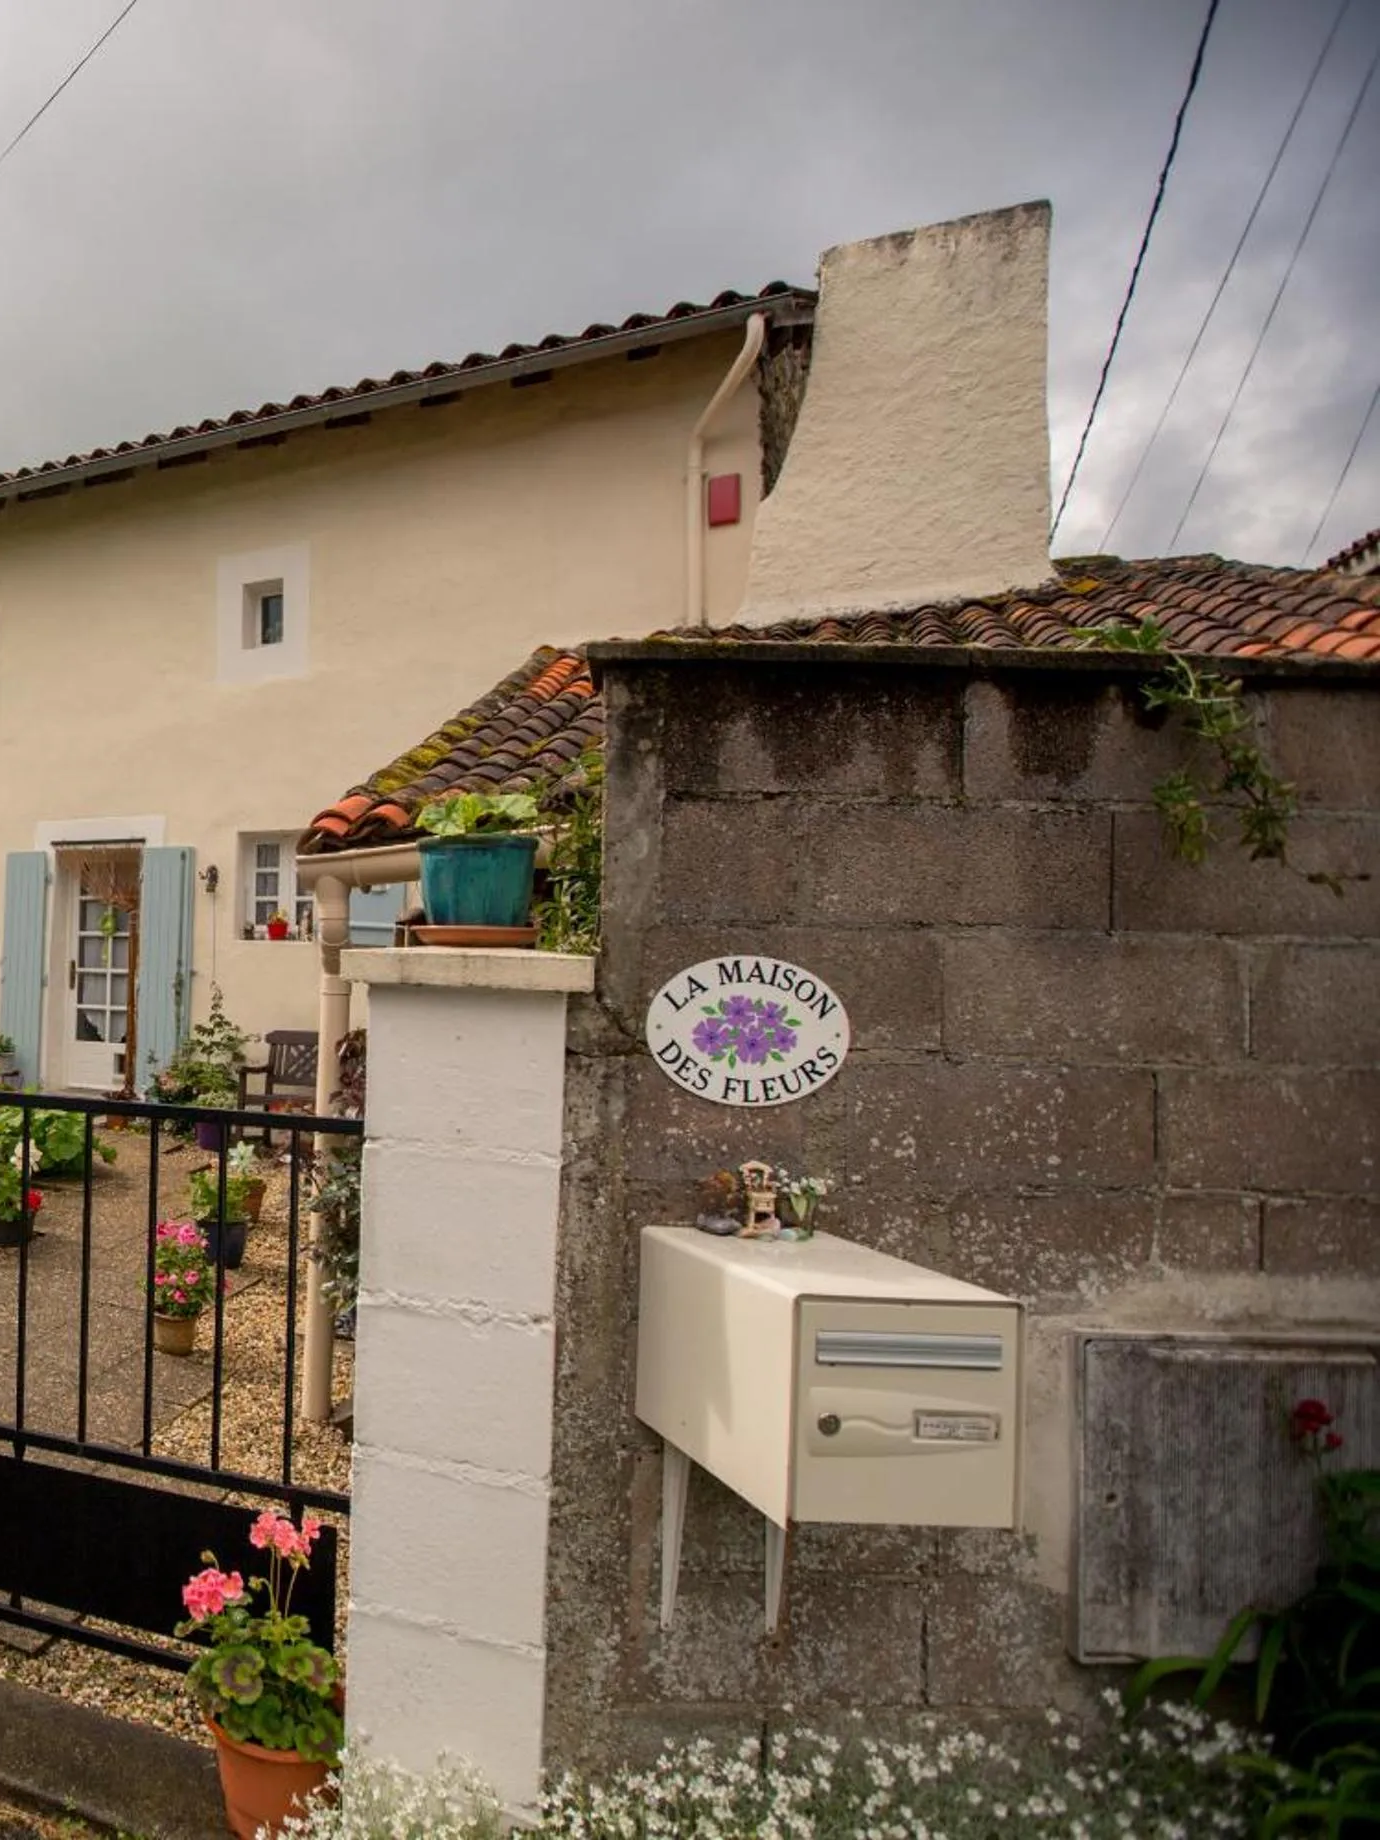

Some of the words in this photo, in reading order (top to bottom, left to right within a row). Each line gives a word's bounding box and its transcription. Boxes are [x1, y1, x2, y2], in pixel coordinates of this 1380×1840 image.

[663, 975, 709, 1012] LA
[717, 960, 838, 1020] MAISON
[657, 1040, 713, 1090] DES
[721, 1046, 838, 1103] FLEURS
